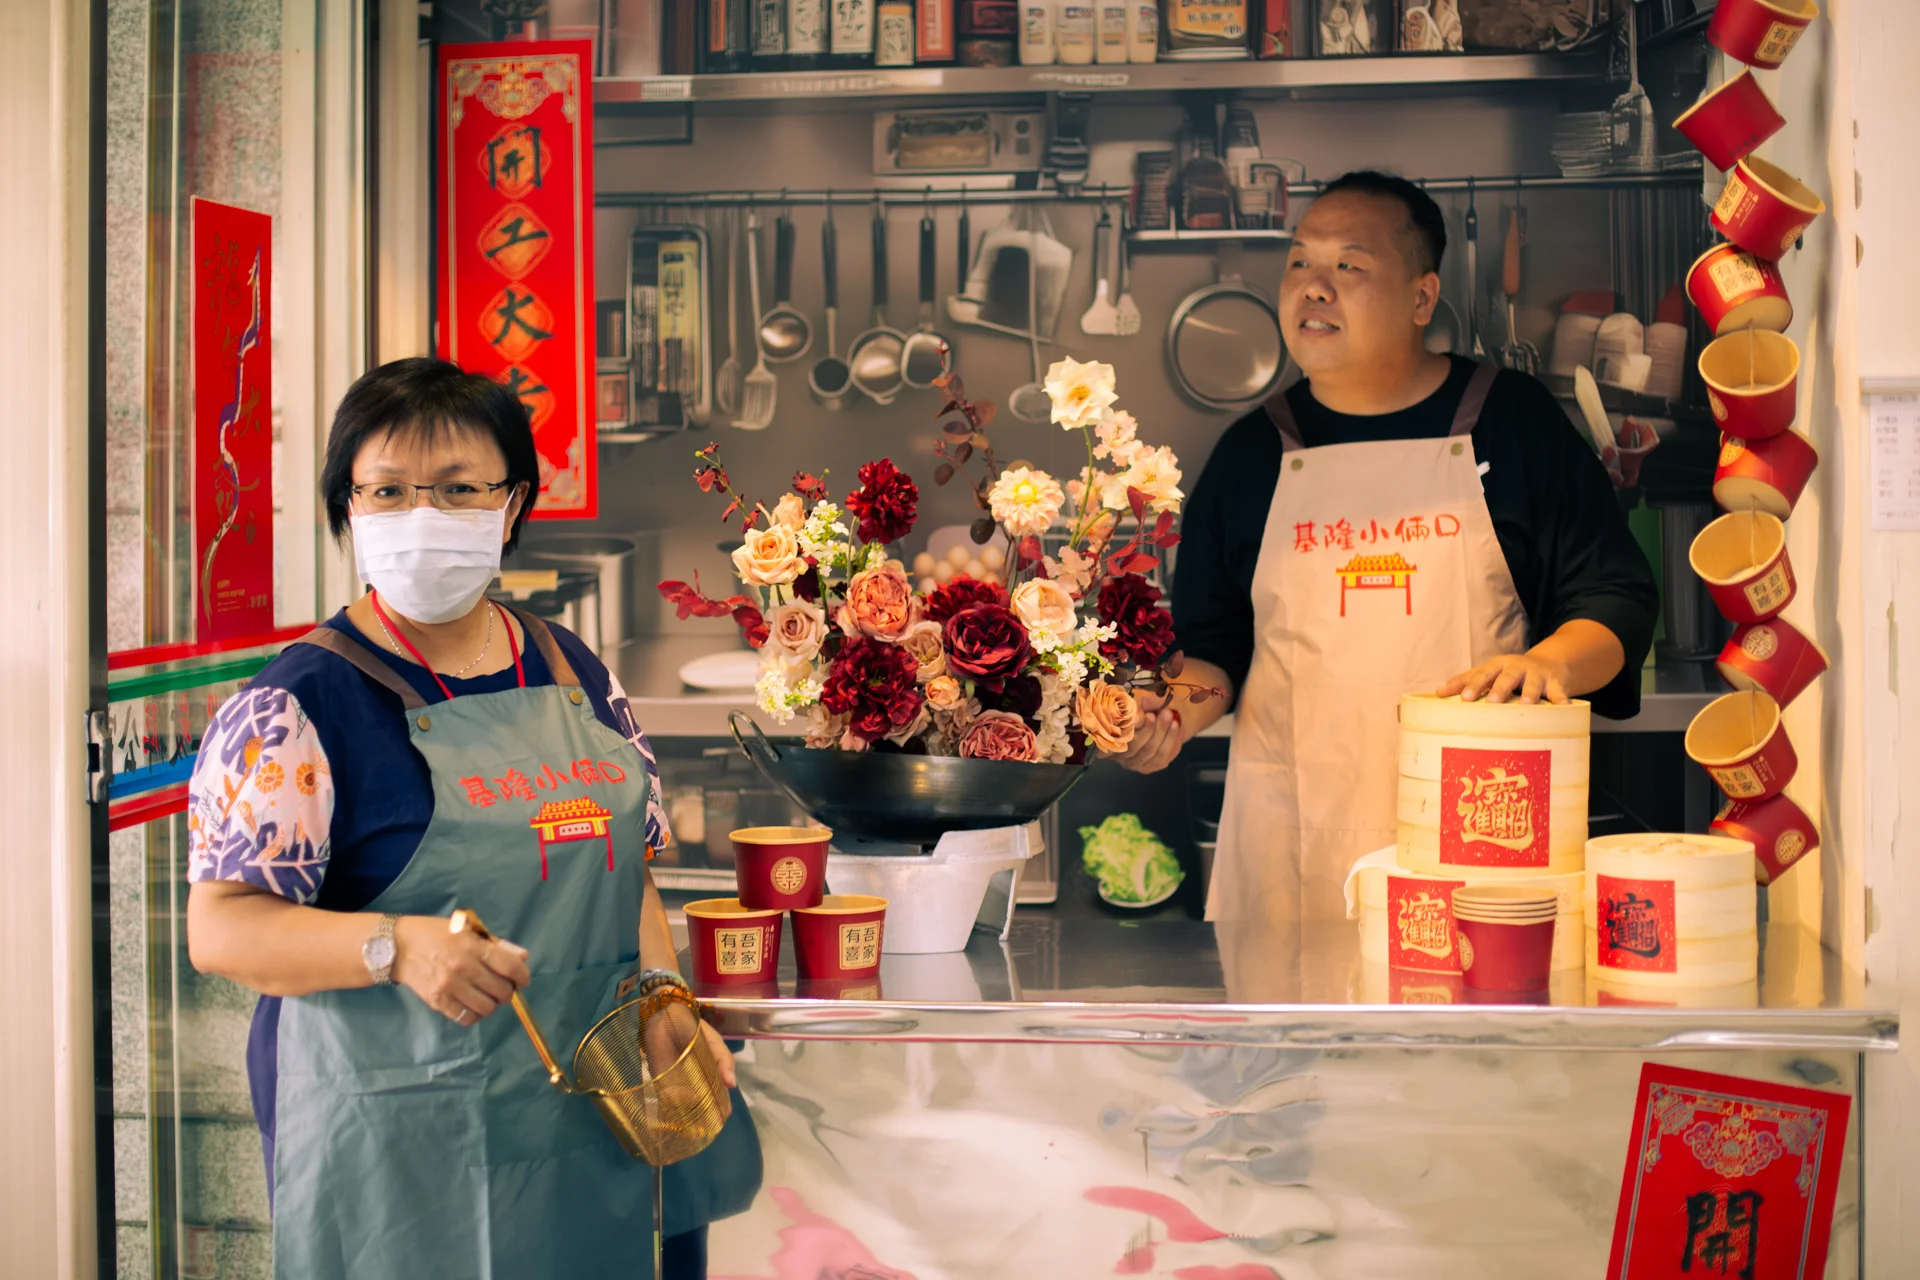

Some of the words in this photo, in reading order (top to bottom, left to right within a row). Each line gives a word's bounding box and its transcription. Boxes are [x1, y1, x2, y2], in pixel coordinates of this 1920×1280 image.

[1292, 513, 1461, 554] 基隆小倆口
[458, 757, 626, 809] 基隆小倆口
[1681, 1189, 1764, 1280] 開
